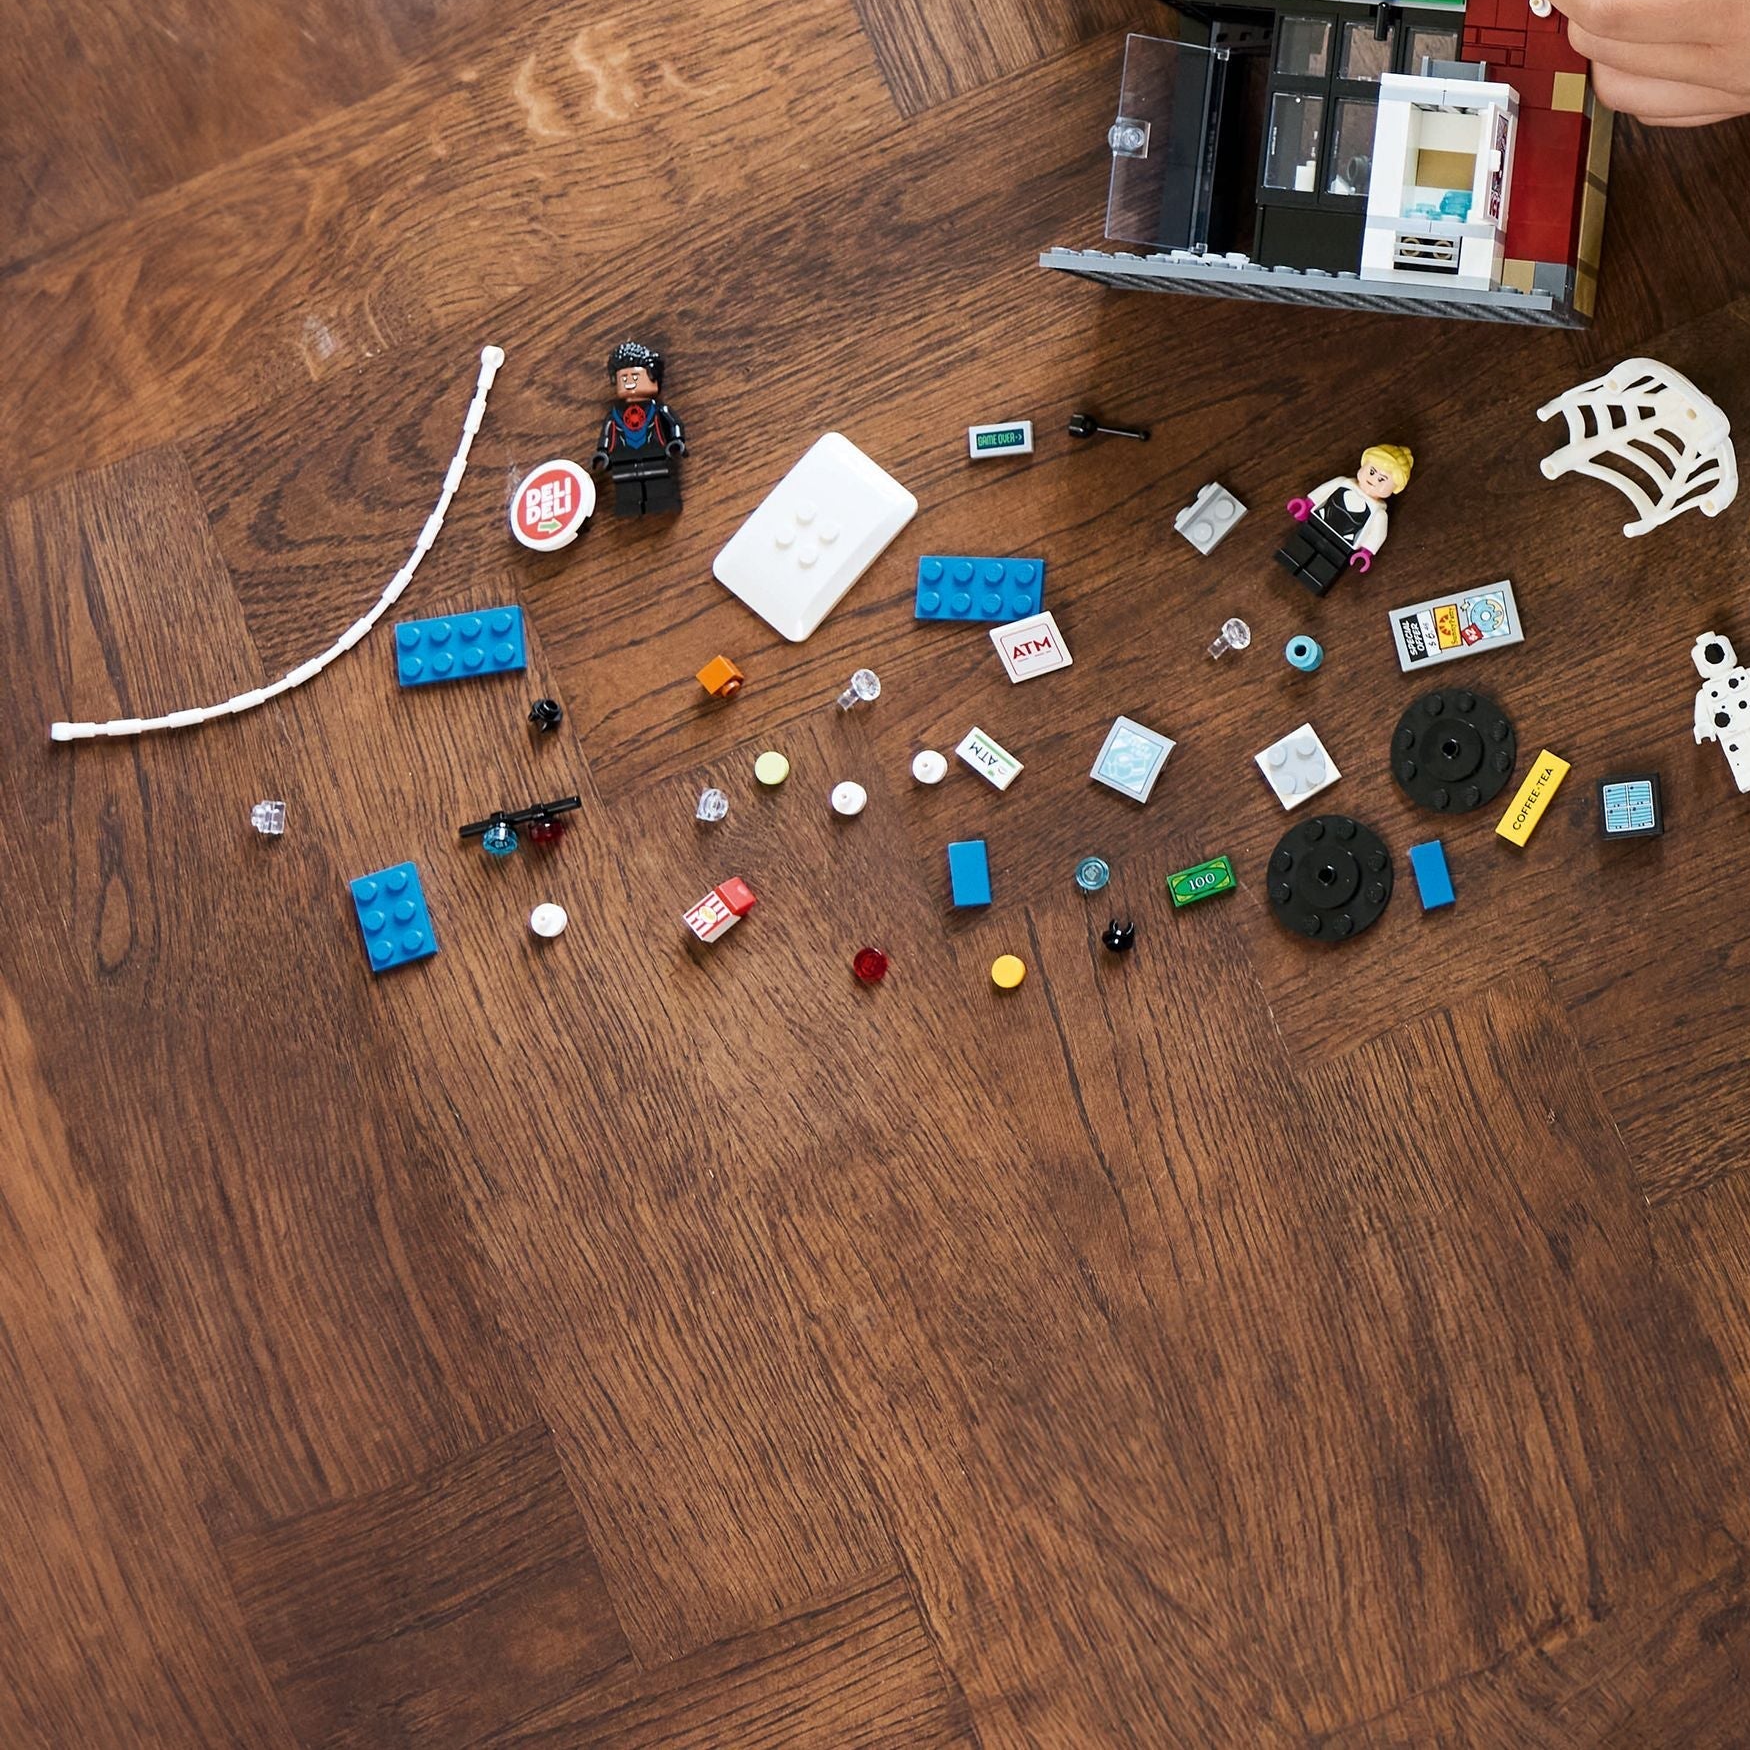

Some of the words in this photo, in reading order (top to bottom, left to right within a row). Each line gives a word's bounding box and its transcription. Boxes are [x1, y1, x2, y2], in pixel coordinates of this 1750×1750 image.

[978, 434, 997, 447] GAME
[998, 432, 1015, 445] OVER
[526, 477, 572, 508] DELI
[526, 494, 572, 526] DELI
[1013, 636, 1052, 660] ATM
[1402, 620, 1418, 656] SPECIAL
[1410, 622, 1425, 652] OFFER
[969, 741, 998, 766] ATM
[1189, 872, 1215, 891] 100
